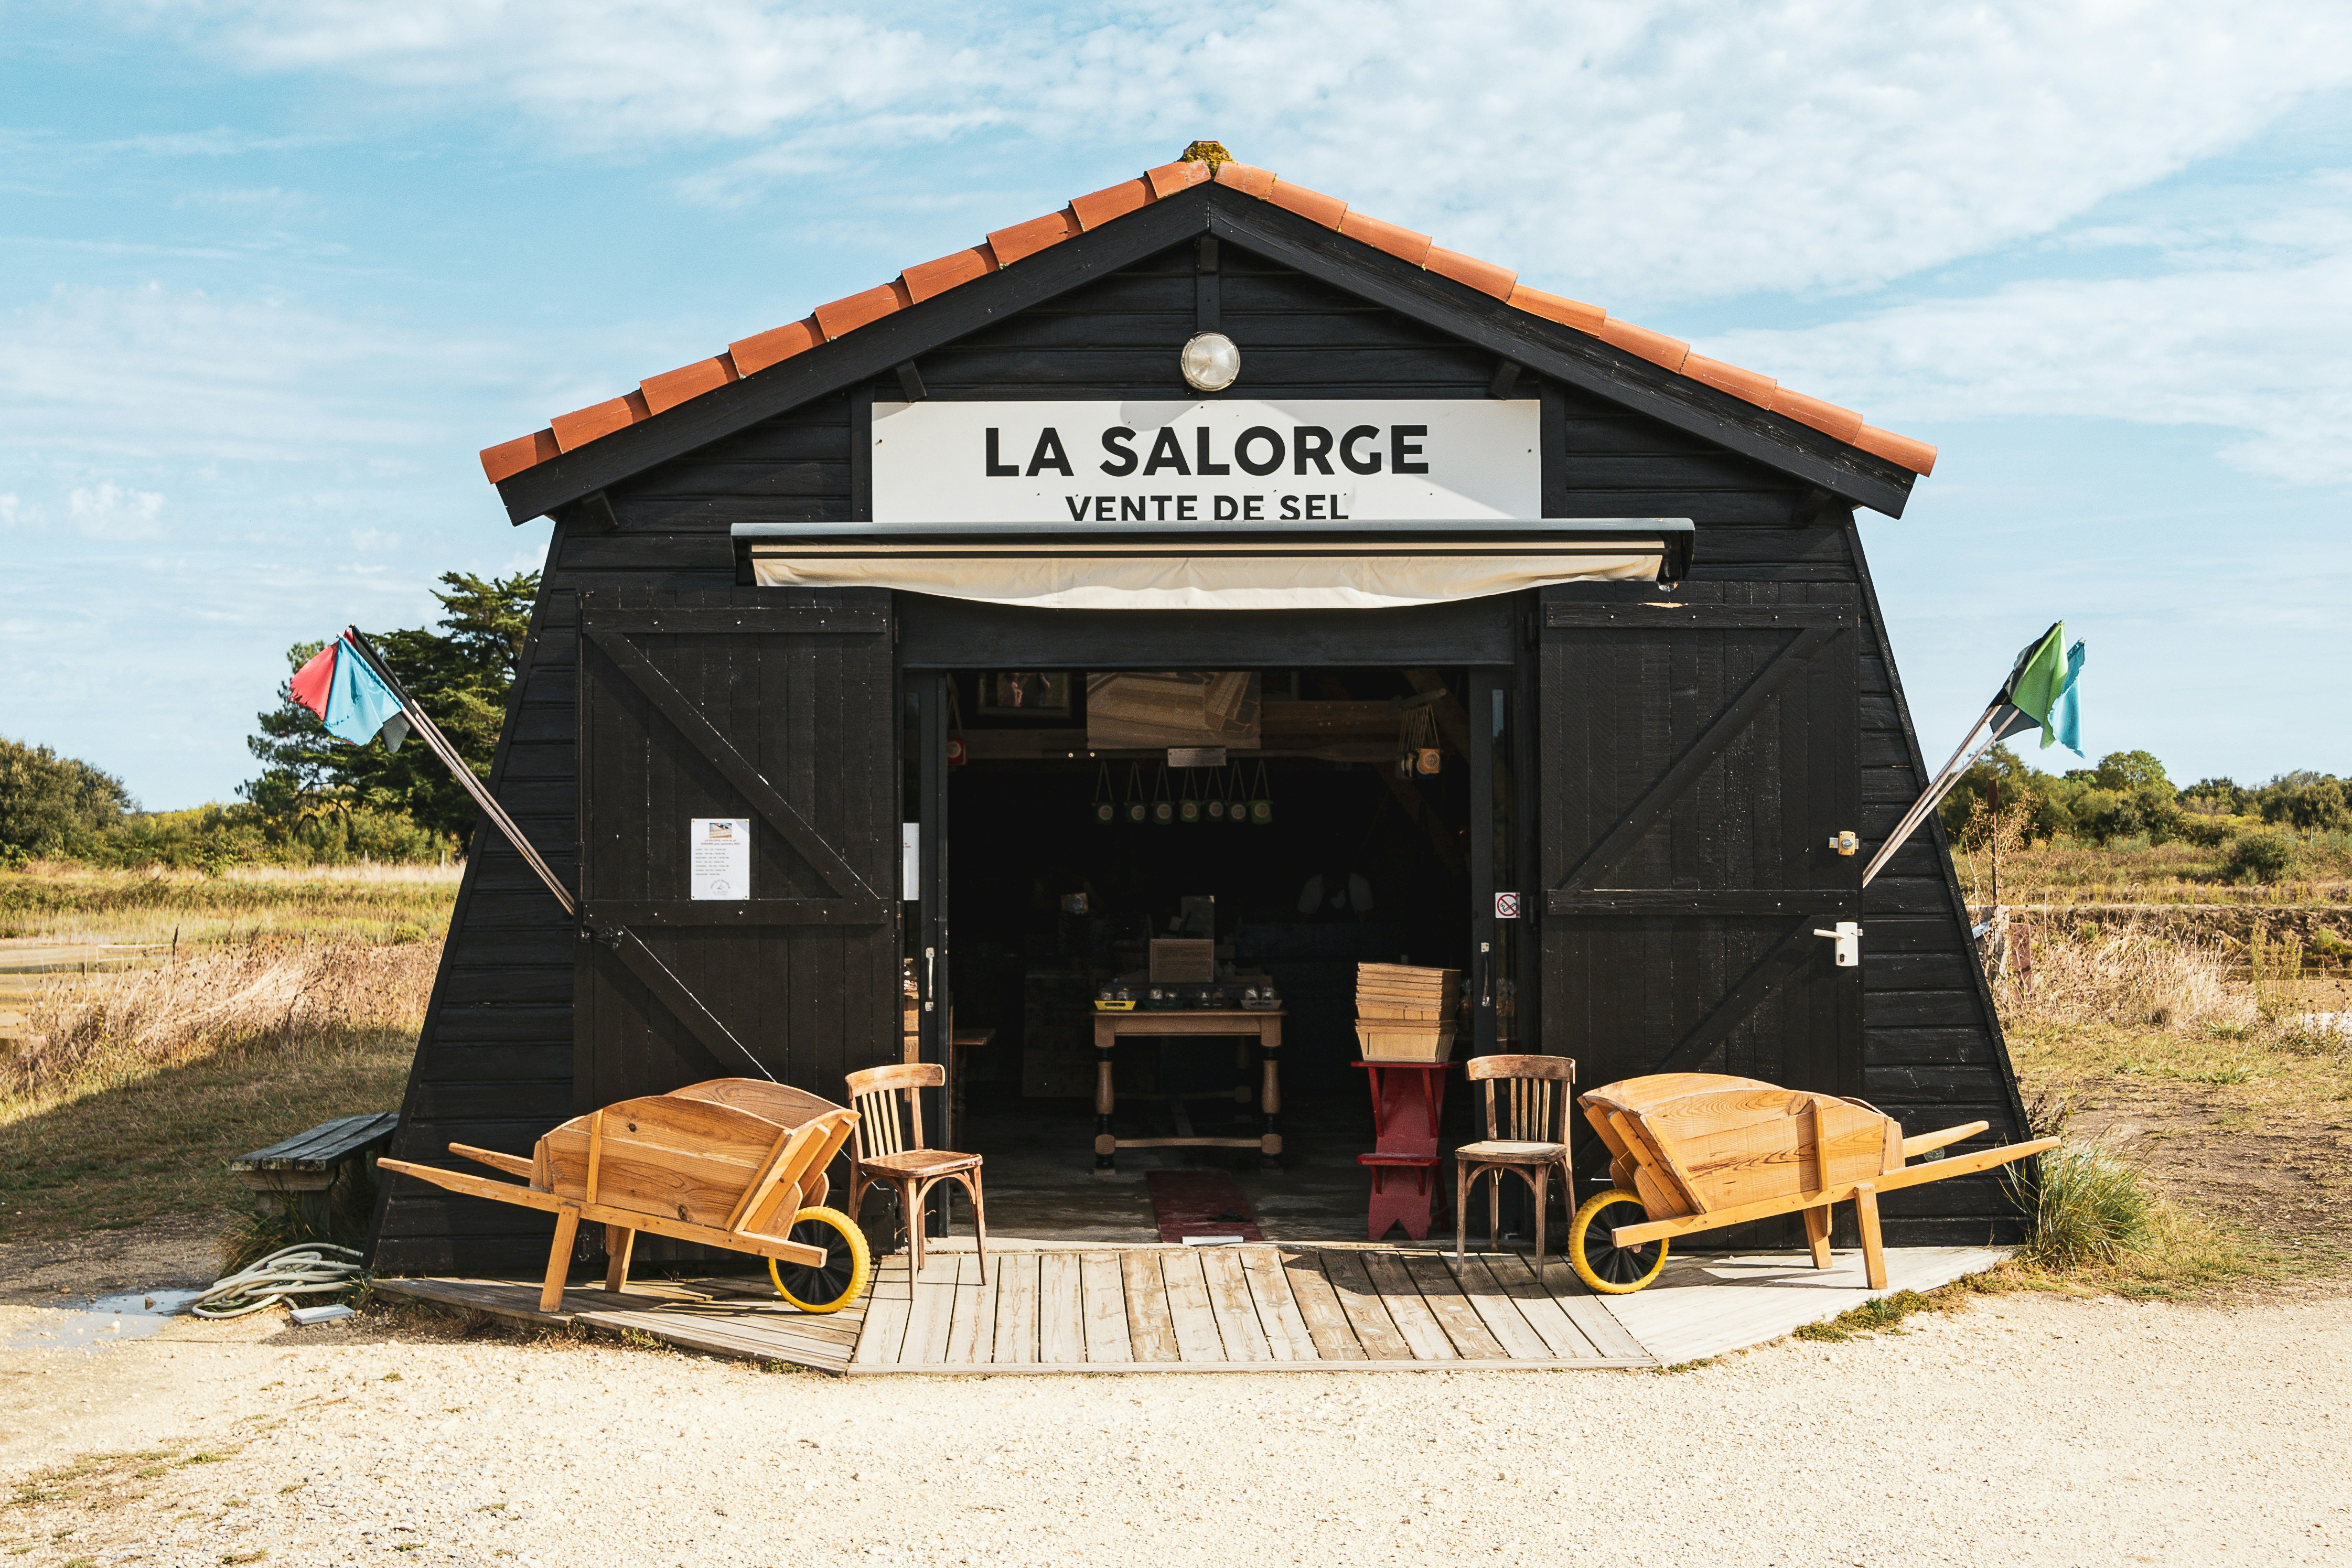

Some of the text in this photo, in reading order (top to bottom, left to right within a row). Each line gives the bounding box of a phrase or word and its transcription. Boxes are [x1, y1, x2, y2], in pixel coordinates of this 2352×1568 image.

[985, 425, 1430, 477] LA SALORGE
[1065, 495, 1349, 521] VENTE DE SEL
